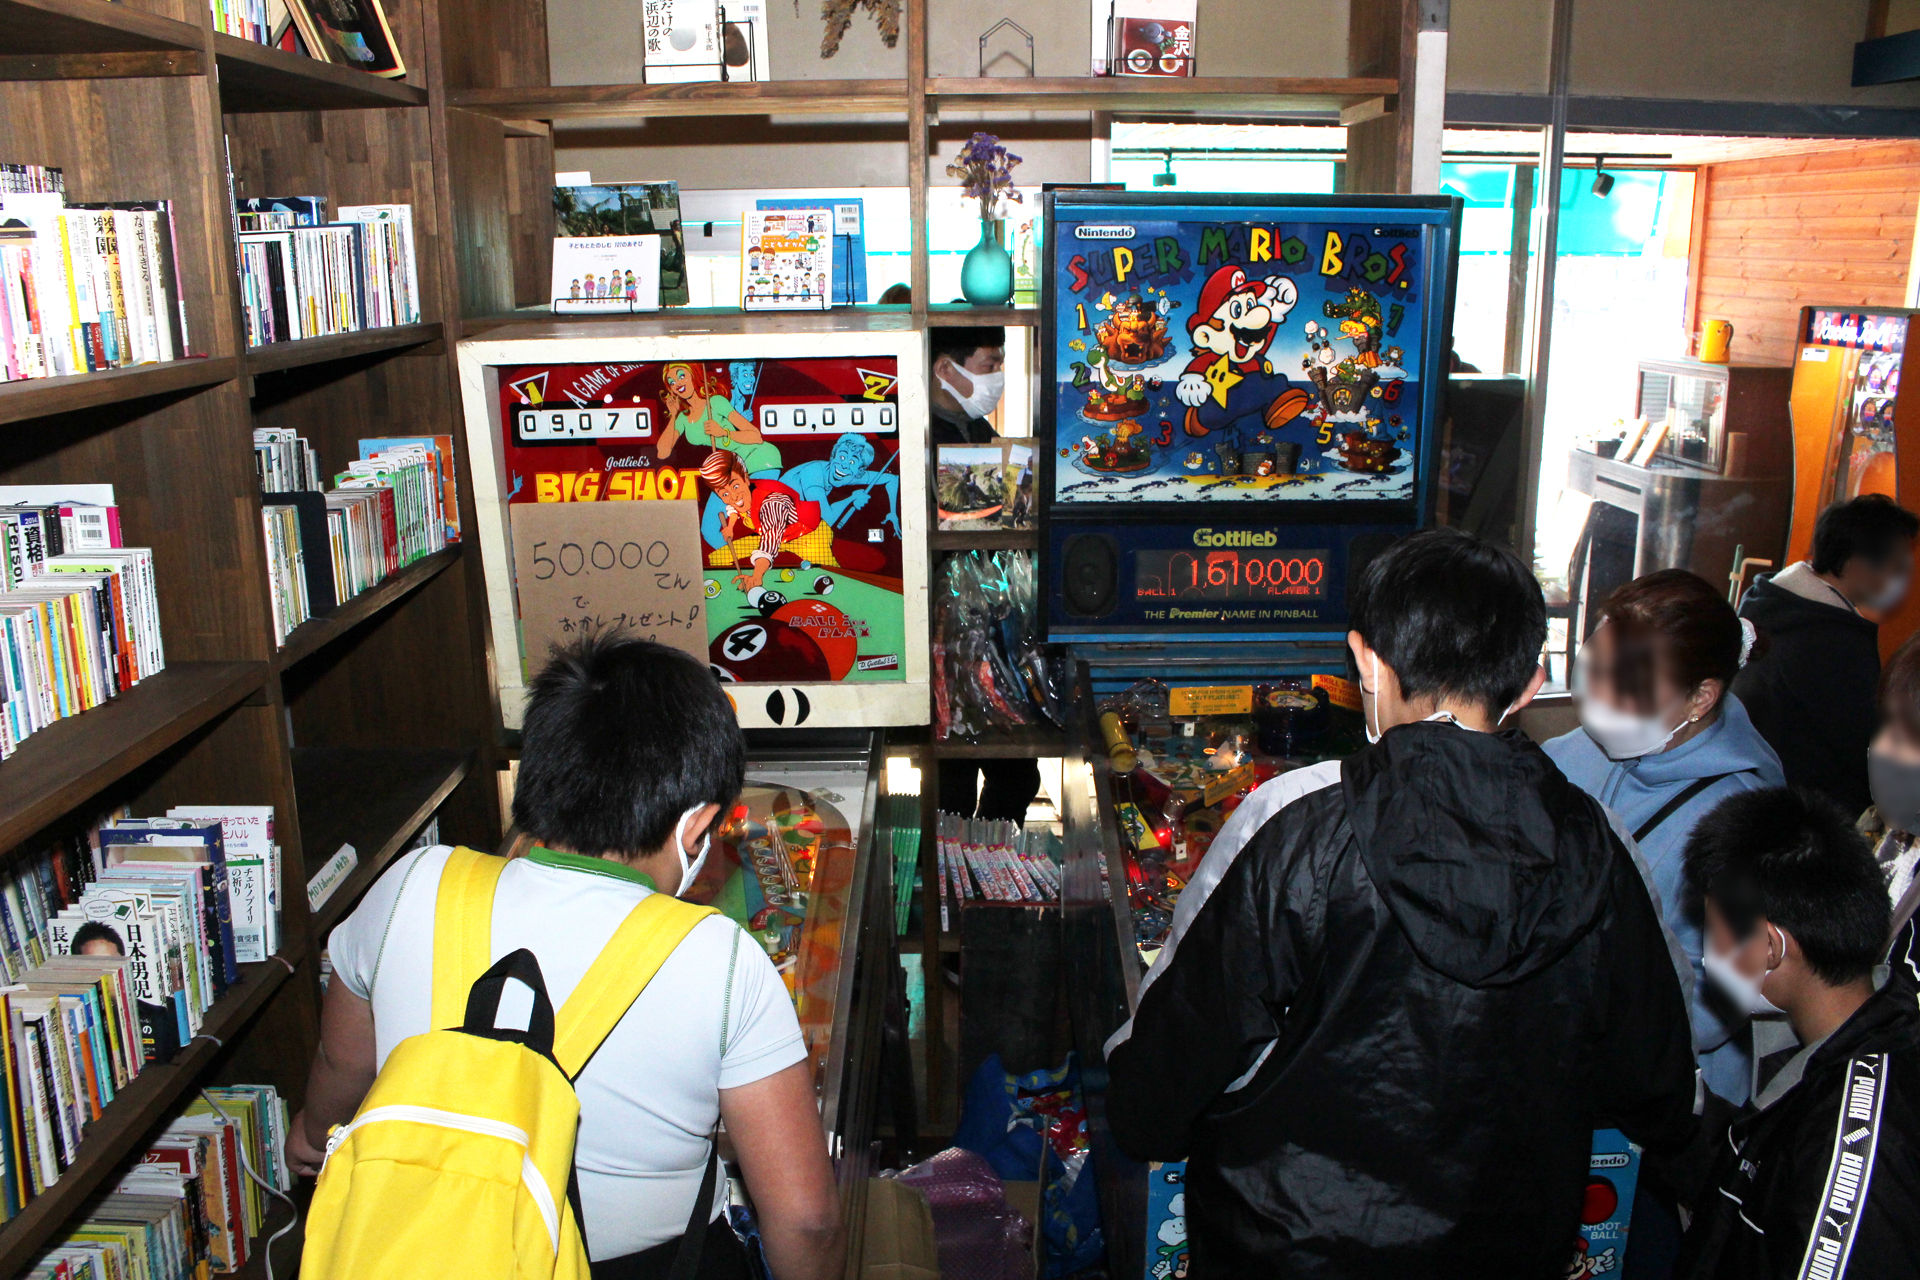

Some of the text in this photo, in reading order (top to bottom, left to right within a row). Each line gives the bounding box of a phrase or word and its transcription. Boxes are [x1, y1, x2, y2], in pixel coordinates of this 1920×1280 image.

[1174, 25, 1191, 56] 金沢
[1078, 227, 1133, 237] Nintendo
[1372, 227, 1420, 239] Gottlieb
[134, 215, 149, 282] なぜ生きる
[1066, 226, 1411, 294] SUPER MARIO BROS.
[1857, 320, 1893, 345] Roll
[572, 368, 612, 399] GAME
[605, 365, 621, 378] OF
[863, 375, 890, 401] 2
[525, 382, 544, 405] 1
[1316, 422, 1334, 444] 5
[605, 455, 651, 471] Gottlieb's
[535, 468, 702, 503] BIG SHOT
[24, 525, 44, 564] 資格
[1193, 528, 1278, 547] Gottlieb
[654, 573, 691, 590] てん
[1190, 557, 1324, 588] 1,610,000
[1137, 588, 1177, 596] BALL 1
[1267, 586, 1320, 595] PLAYER 1
[573, 595, 590, 609] で
[1144, 607, 1319, 619] THE Premier NAME IN PINBALL
[788, 615, 837, 627] BALL
[727, 627, 764, 657] 4
[818, 627, 872, 638] PLAY
[231, 868, 243, 897] の祈り
[126, 924, 152, 999] 日本男児
[1848, 1075, 1876, 1122] PUMA
[1842, 1126, 1871, 1145] PUMA
[1591, 1156, 1626, 1166] endo
[1829, 1151, 1864, 1215] PUMA
[1581, 1222, 1622, 1232] SHOOT
[1590, 1231, 1619, 1240] BALL
